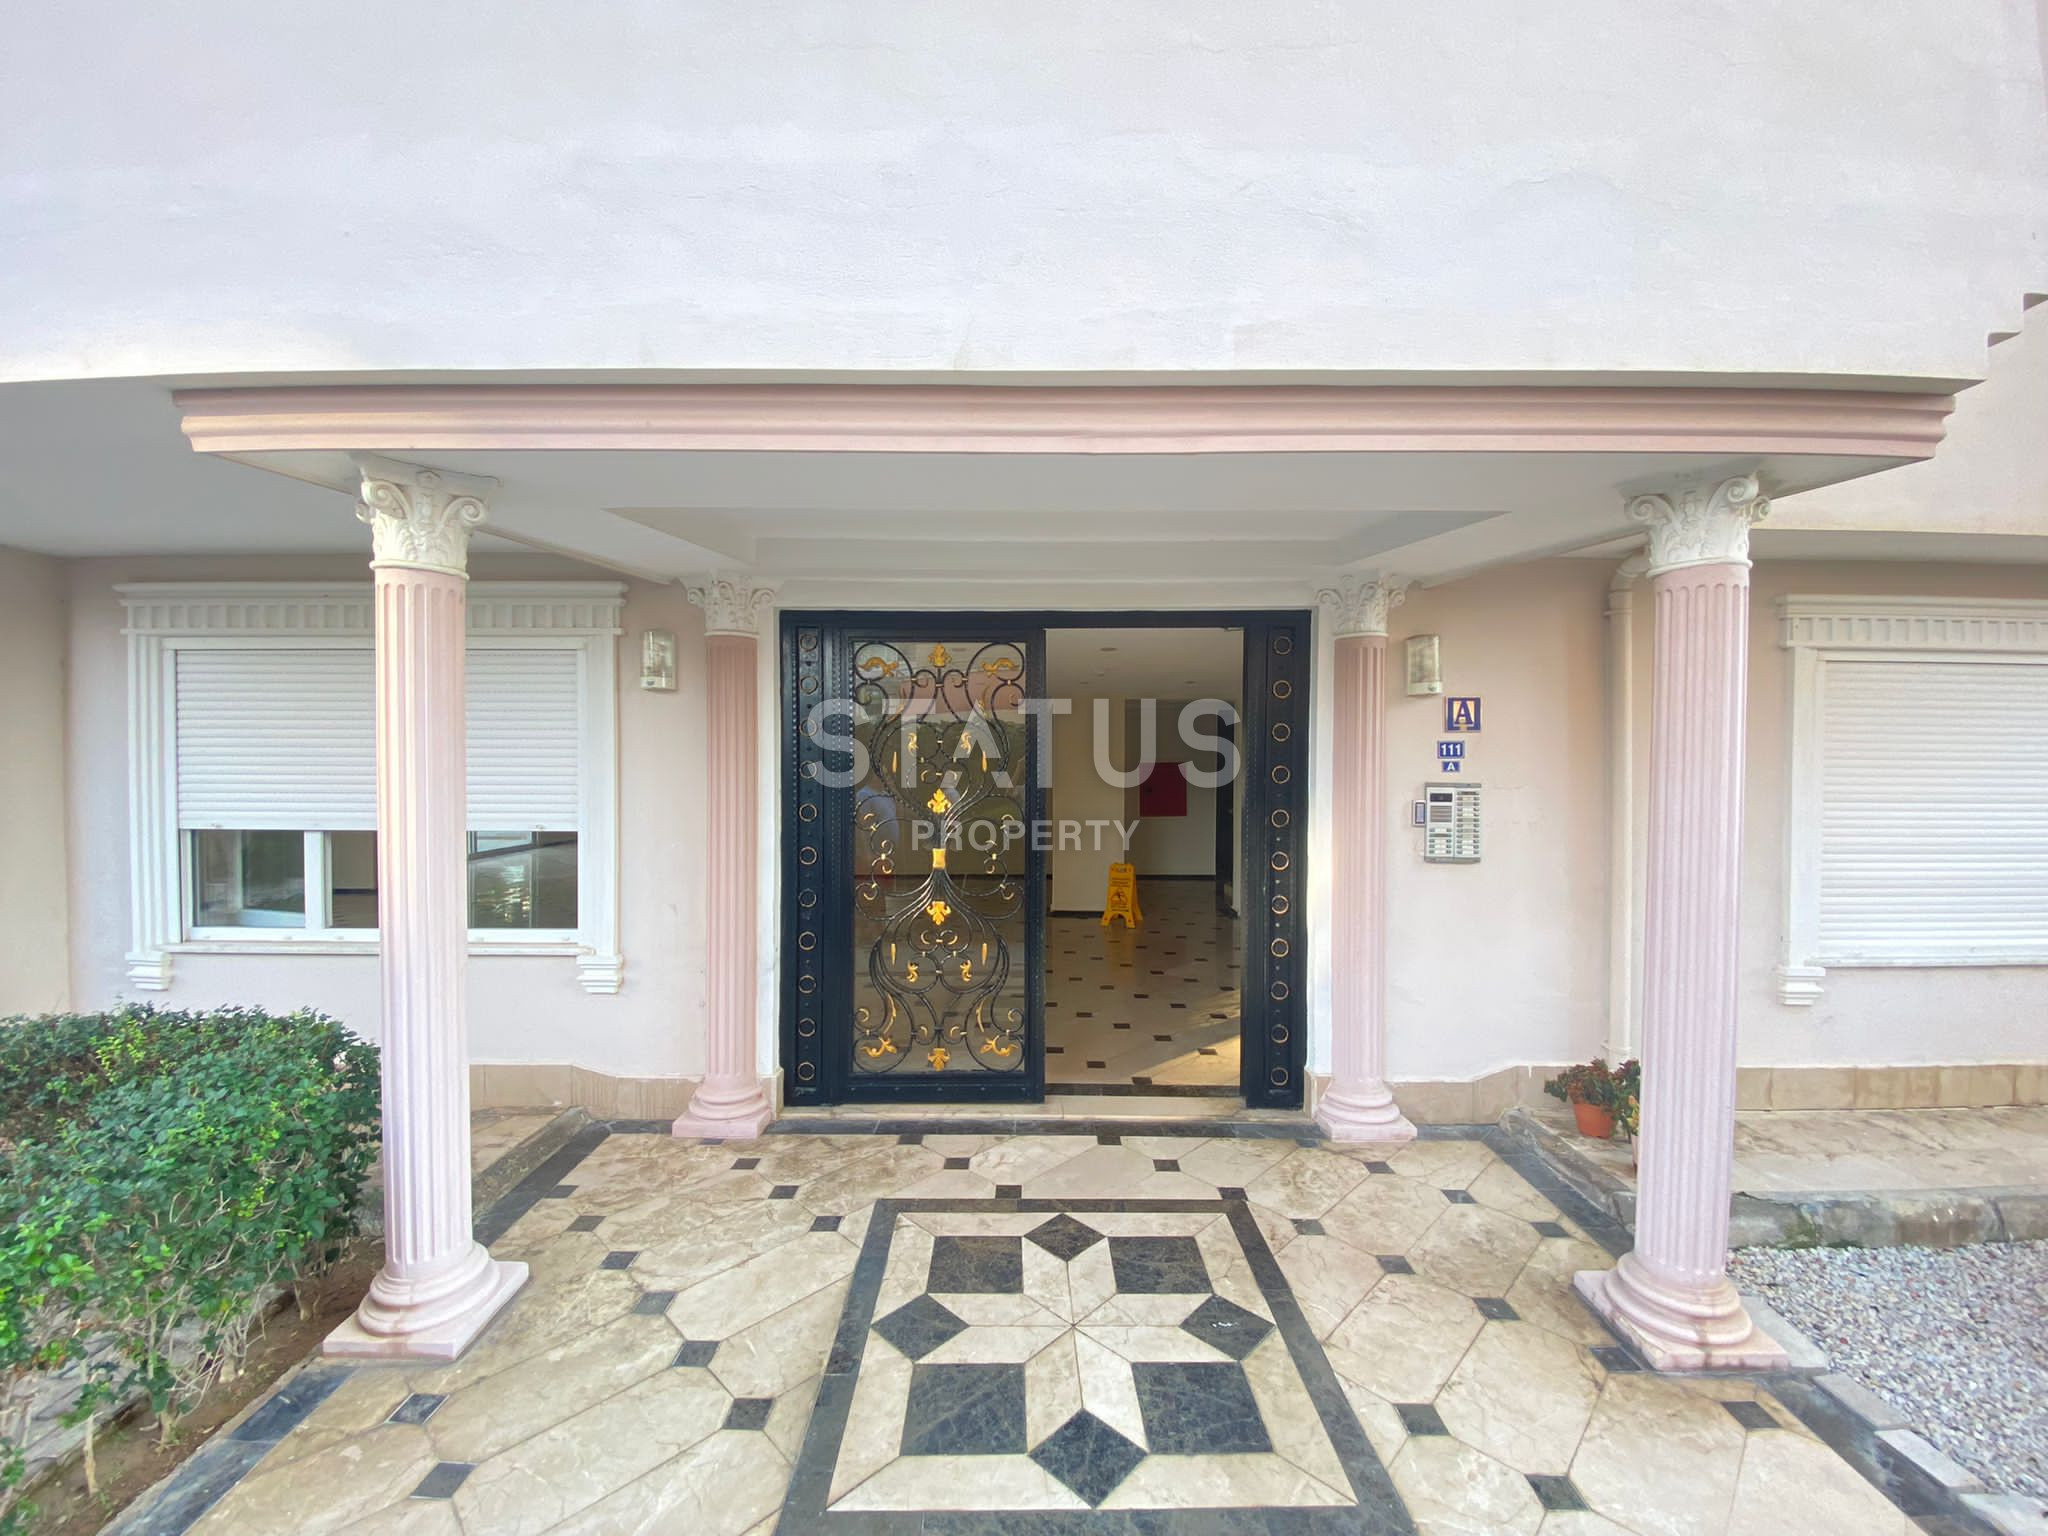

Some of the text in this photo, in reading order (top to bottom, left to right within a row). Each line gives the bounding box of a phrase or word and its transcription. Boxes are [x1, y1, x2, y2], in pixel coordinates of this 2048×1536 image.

[1454, 698, 1474, 725] A
[1441, 743, 1461, 756] 111
[1447, 762, 1456, 771] A
